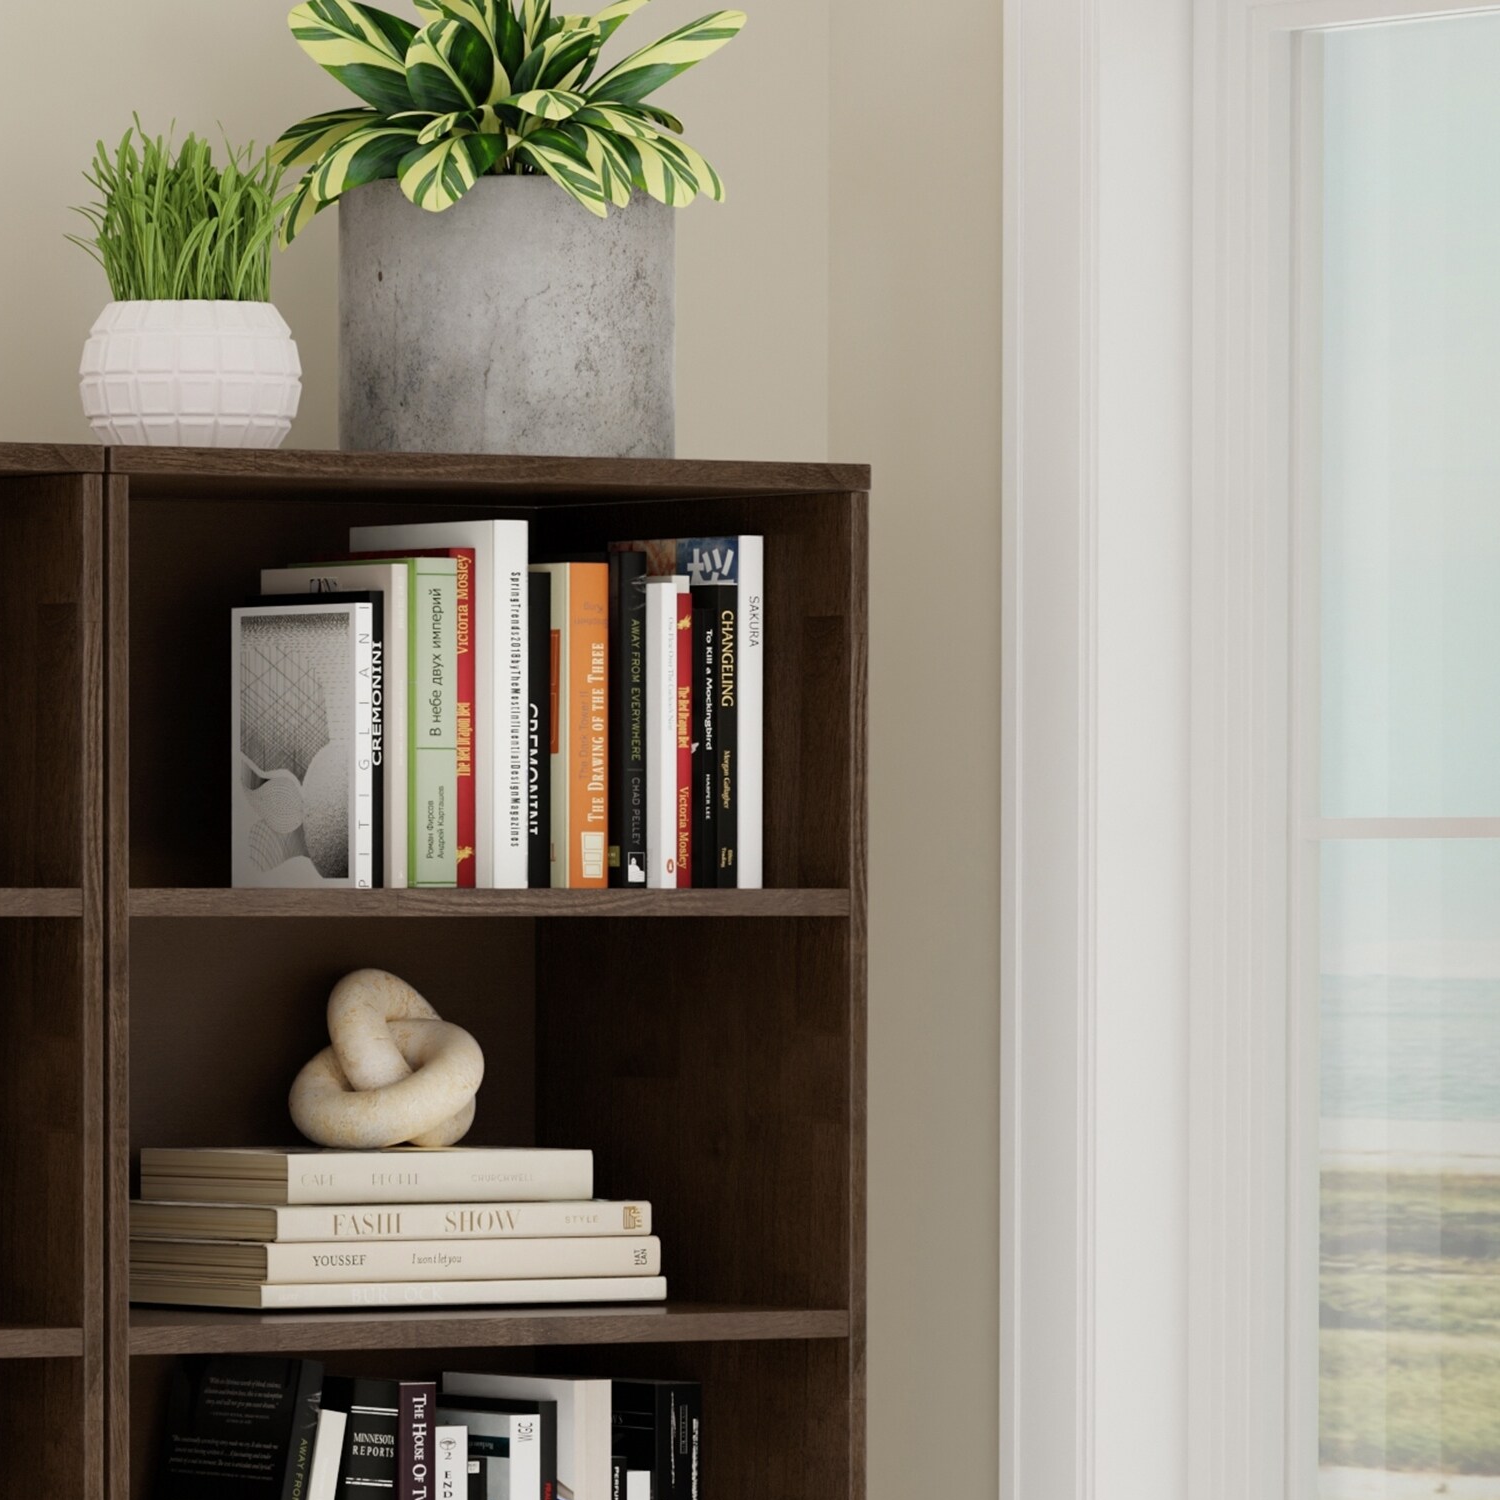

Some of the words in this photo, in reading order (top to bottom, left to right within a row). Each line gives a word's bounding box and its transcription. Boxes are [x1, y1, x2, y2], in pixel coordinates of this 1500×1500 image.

[457, 555, 471, 600] Mosley
[427, 588, 444, 649] империй
[457, 604, 469, 655] Victoria
[631, 619, 641, 649] AWAY
[748, 596, 760, 648] SAKURA
[704, 628, 713, 645] To
[431, 653, 444, 686] двух
[587, 642, 604, 683] THREE
[631, 652, 641, 683] FROM
[704, 646, 713, 664] Kill
[704, 666, 713, 675] a
[721, 610, 734, 707] CHANGELING
[372, 641, 382, 766] CREMONINI
[428, 690, 442, 723] небе
[590, 688, 604, 704] THE
[590, 717, 604, 731] OF
[631, 687, 641, 761] EVERYWHERE
[704, 677, 713, 751] Mockingbird
[357, 606, 370, 888] PITIGLIANI
[429, 727, 442, 737] В
[587, 737, 604, 791] DRAWING
[722, 750, 731, 776] Morgan
[631, 777, 640, 805] CHAD
[722, 777, 731, 809] Gallagher
[587, 797, 604, 822] THE
[679, 786, 689, 829] Victoria
[631, 808, 640, 845] PELLEY
[676, 832, 689, 869] Mosley
[470, 1173, 534, 1183] CHURCHWELL
[444, 1209, 521, 1233] SHOW
[565, 1215, 599, 1224] STYLE
[312, 1254, 367, 1267] YOUSSEF
[445, 1255, 462, 1268] you
[412, 1394, 427, 1420] THE
[353, 1432, 395, 1446] MINNESOTA
[412, 1423, 427, 1462] HOUSE
[517, 1422, 533, 1442] WGC
[296, 1438, 309, 1470] AWAY
[352, 1445, 395, 1459] REPORTS
[412, 1464, 427, 1484] OF
